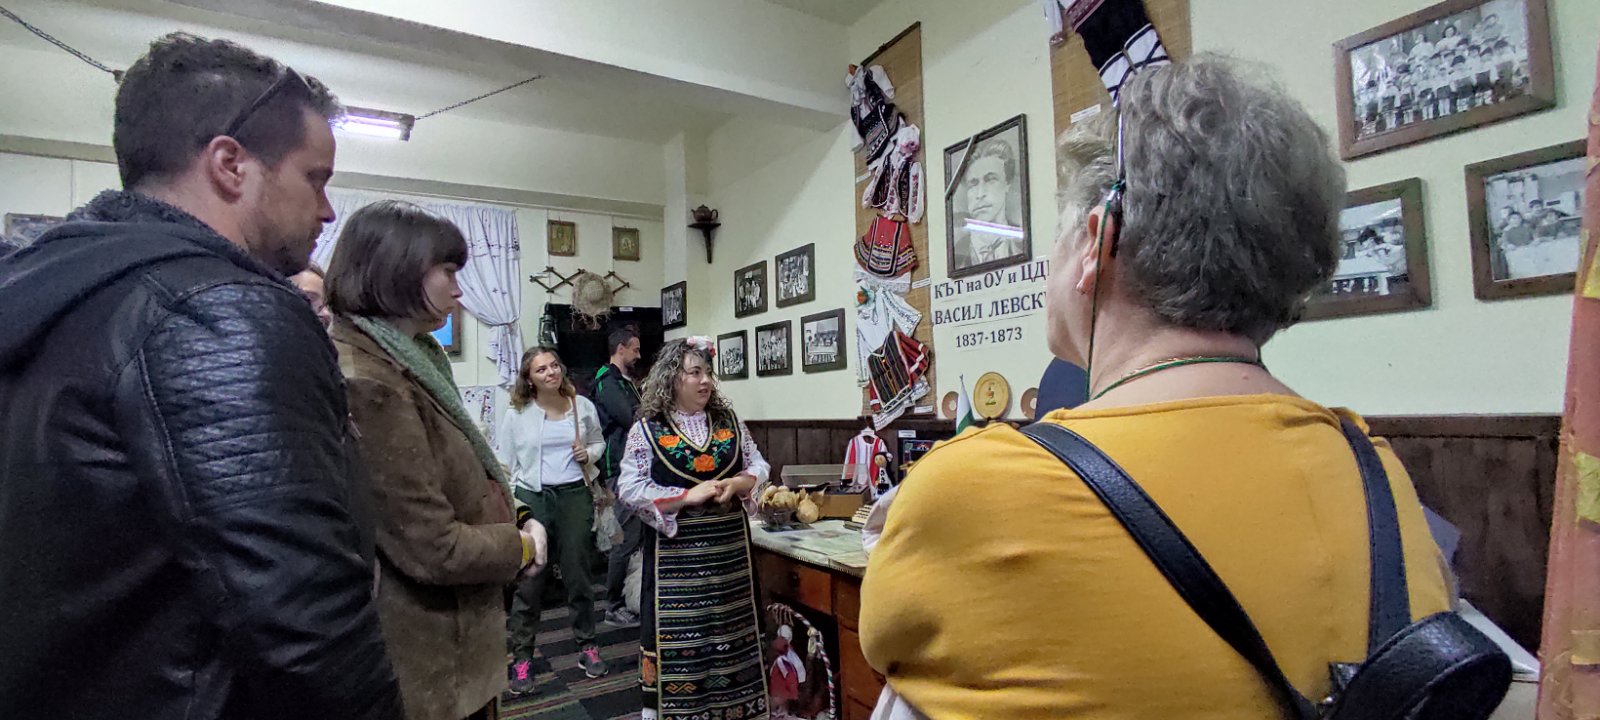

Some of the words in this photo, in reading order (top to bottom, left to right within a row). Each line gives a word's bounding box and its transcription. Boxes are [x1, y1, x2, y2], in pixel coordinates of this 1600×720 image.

[934, 279, 964, 299] КЪТ
[966, 280, 982, 293] на
[984, 269, 1005, 288] ОУ
[1008, 271, 1017, 284] и
[988, 291, 1047, 318] ЛЕВСК
[956, 326, 1023, 348] 1837-1873
